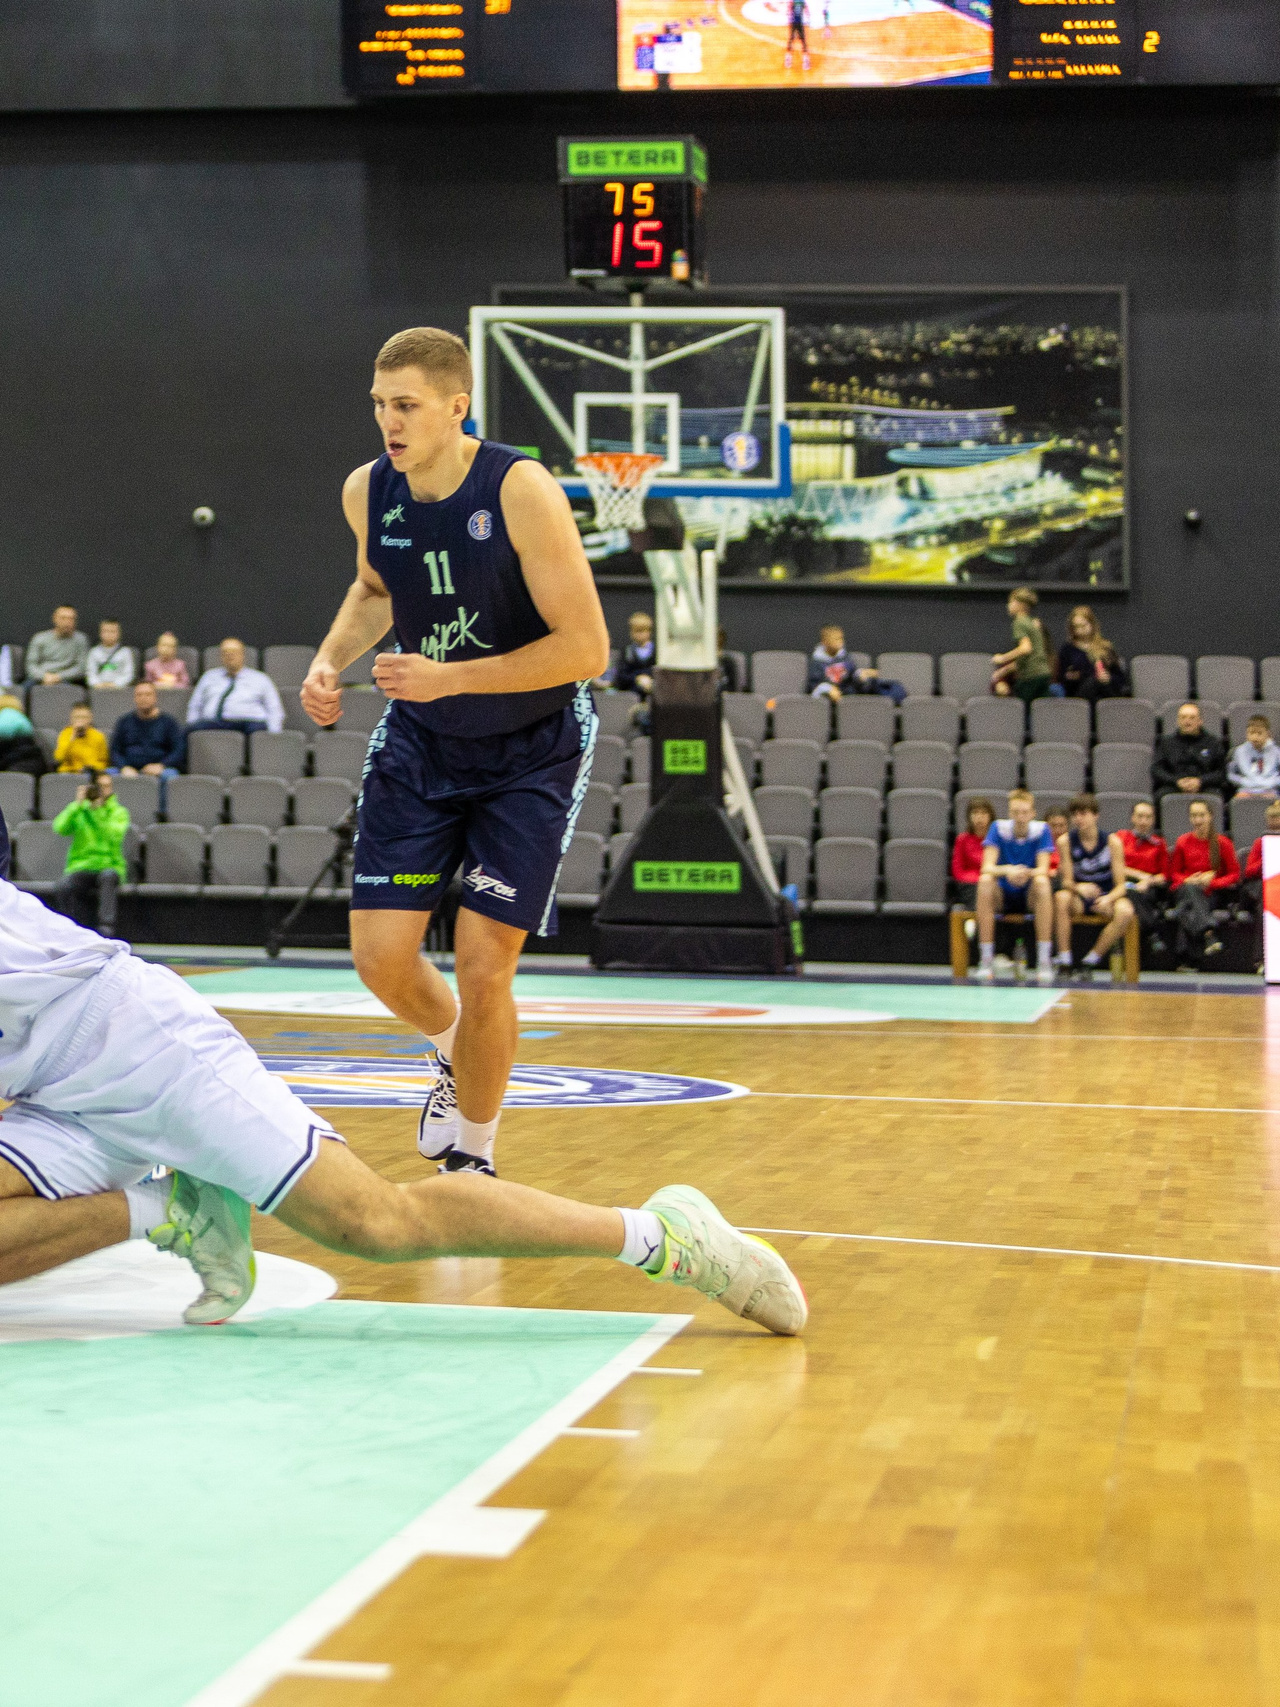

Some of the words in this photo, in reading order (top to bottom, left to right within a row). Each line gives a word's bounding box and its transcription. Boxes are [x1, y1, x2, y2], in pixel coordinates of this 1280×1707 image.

[1142, 31, 1160, 53] 2
[576, 149, 677, 167] BETERA
[604, 182, 655, 217] 75
[611, 220, 663, 268] 15
[380, 535, 412, 549] Kempa
[423, 550, 456, 595] 11
[354, 873, 390, 886] Kempa
[641, 868, 733, 884] BETERA
